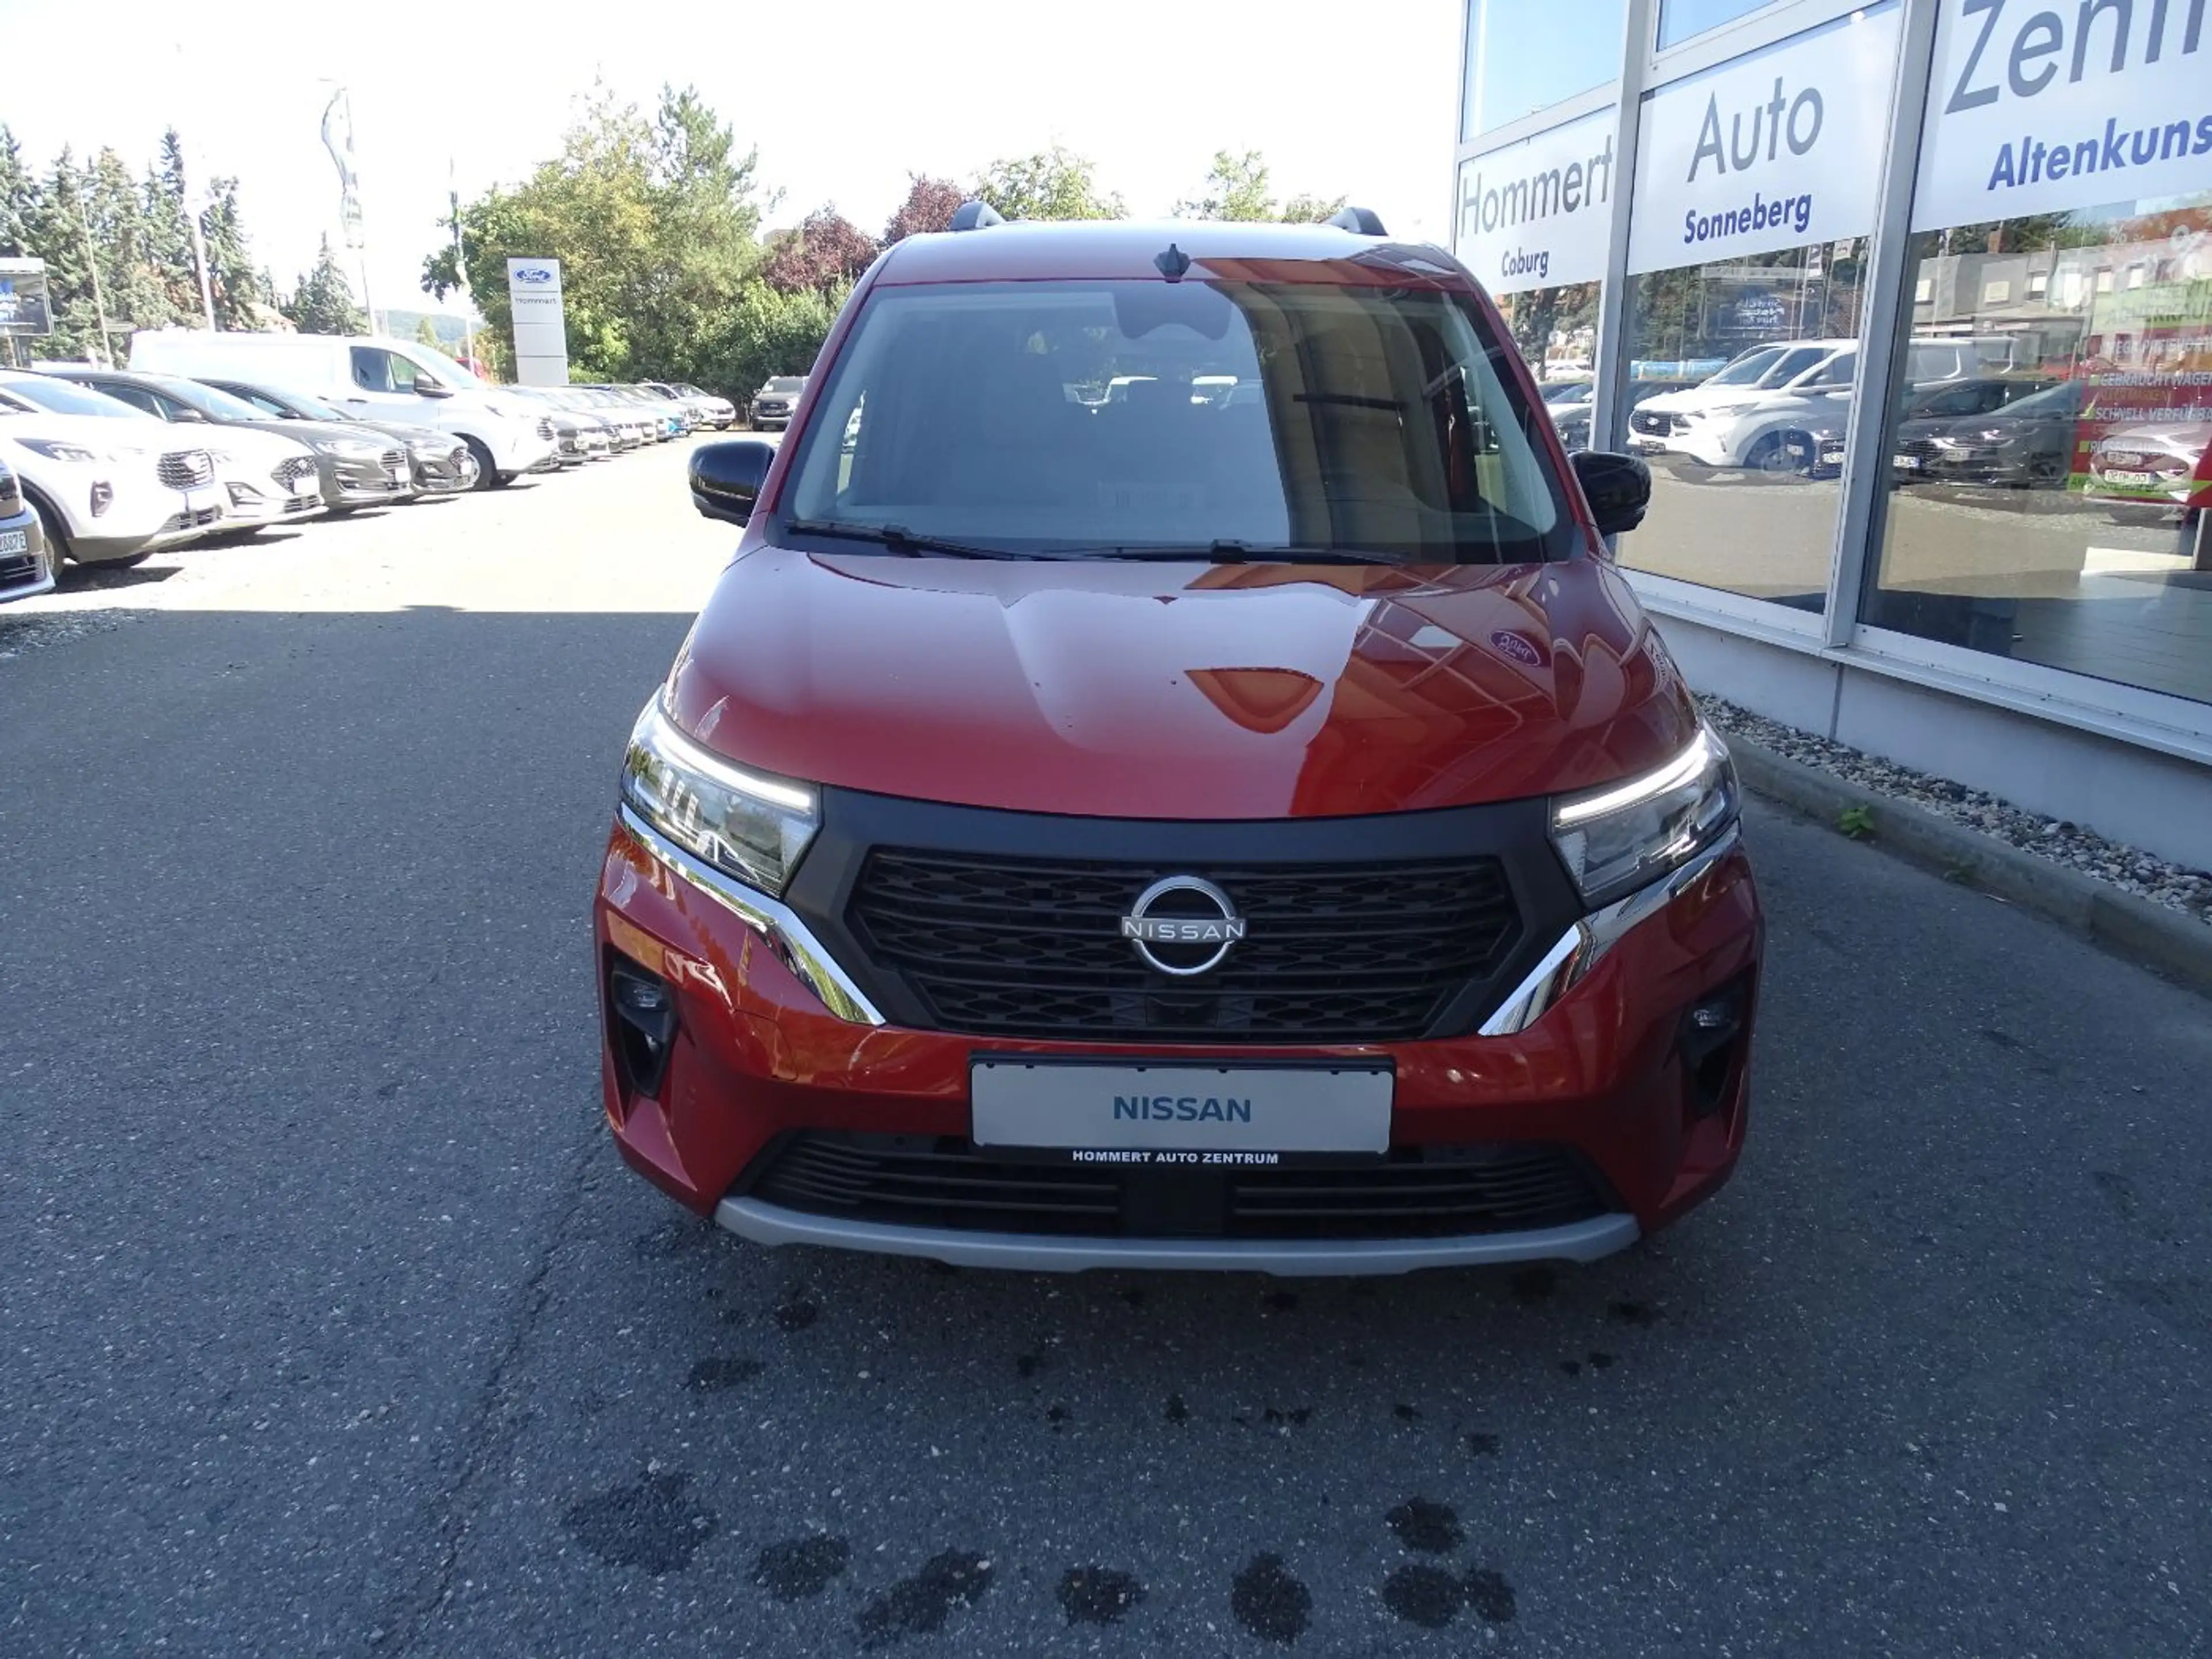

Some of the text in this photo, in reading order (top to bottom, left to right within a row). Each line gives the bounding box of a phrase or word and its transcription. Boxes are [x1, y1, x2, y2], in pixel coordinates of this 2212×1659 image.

[1461, 134, 1612, 237] Hommert
[1687, 76, 1823, 183] Auto
[1684, 192, 1812, 244] Sonneberg
[1501, 247, 1550, 278] Coburg
[1124, 921, 1244, 940] NISSAN
[1113, 1096, 1251, 1123] NISSAN
[1072, 1150, 1279, 1164] HOMMERT AUTO ZENTRUM
